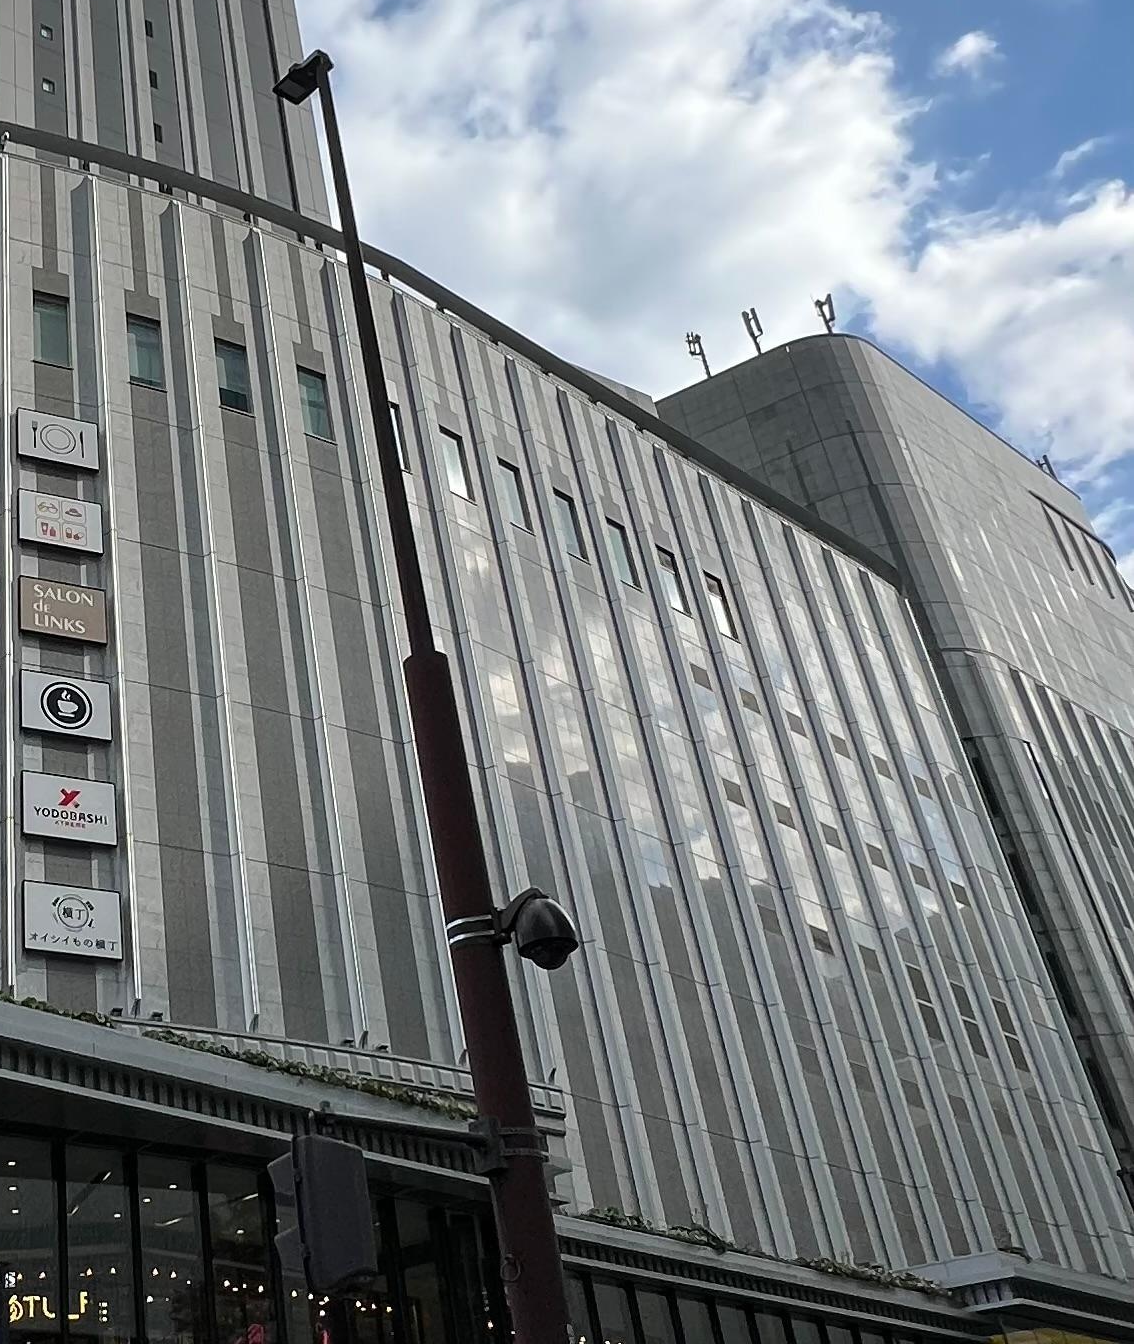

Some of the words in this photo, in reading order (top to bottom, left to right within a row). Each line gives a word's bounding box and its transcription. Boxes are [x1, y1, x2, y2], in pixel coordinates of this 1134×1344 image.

[32, 583, 95, 607] SALON
[33, 613, 86, 635] LINKS
[33, 806, 108, 825] YODOBASHI
[28, 932, 118, 952] オイシイもの横丁
